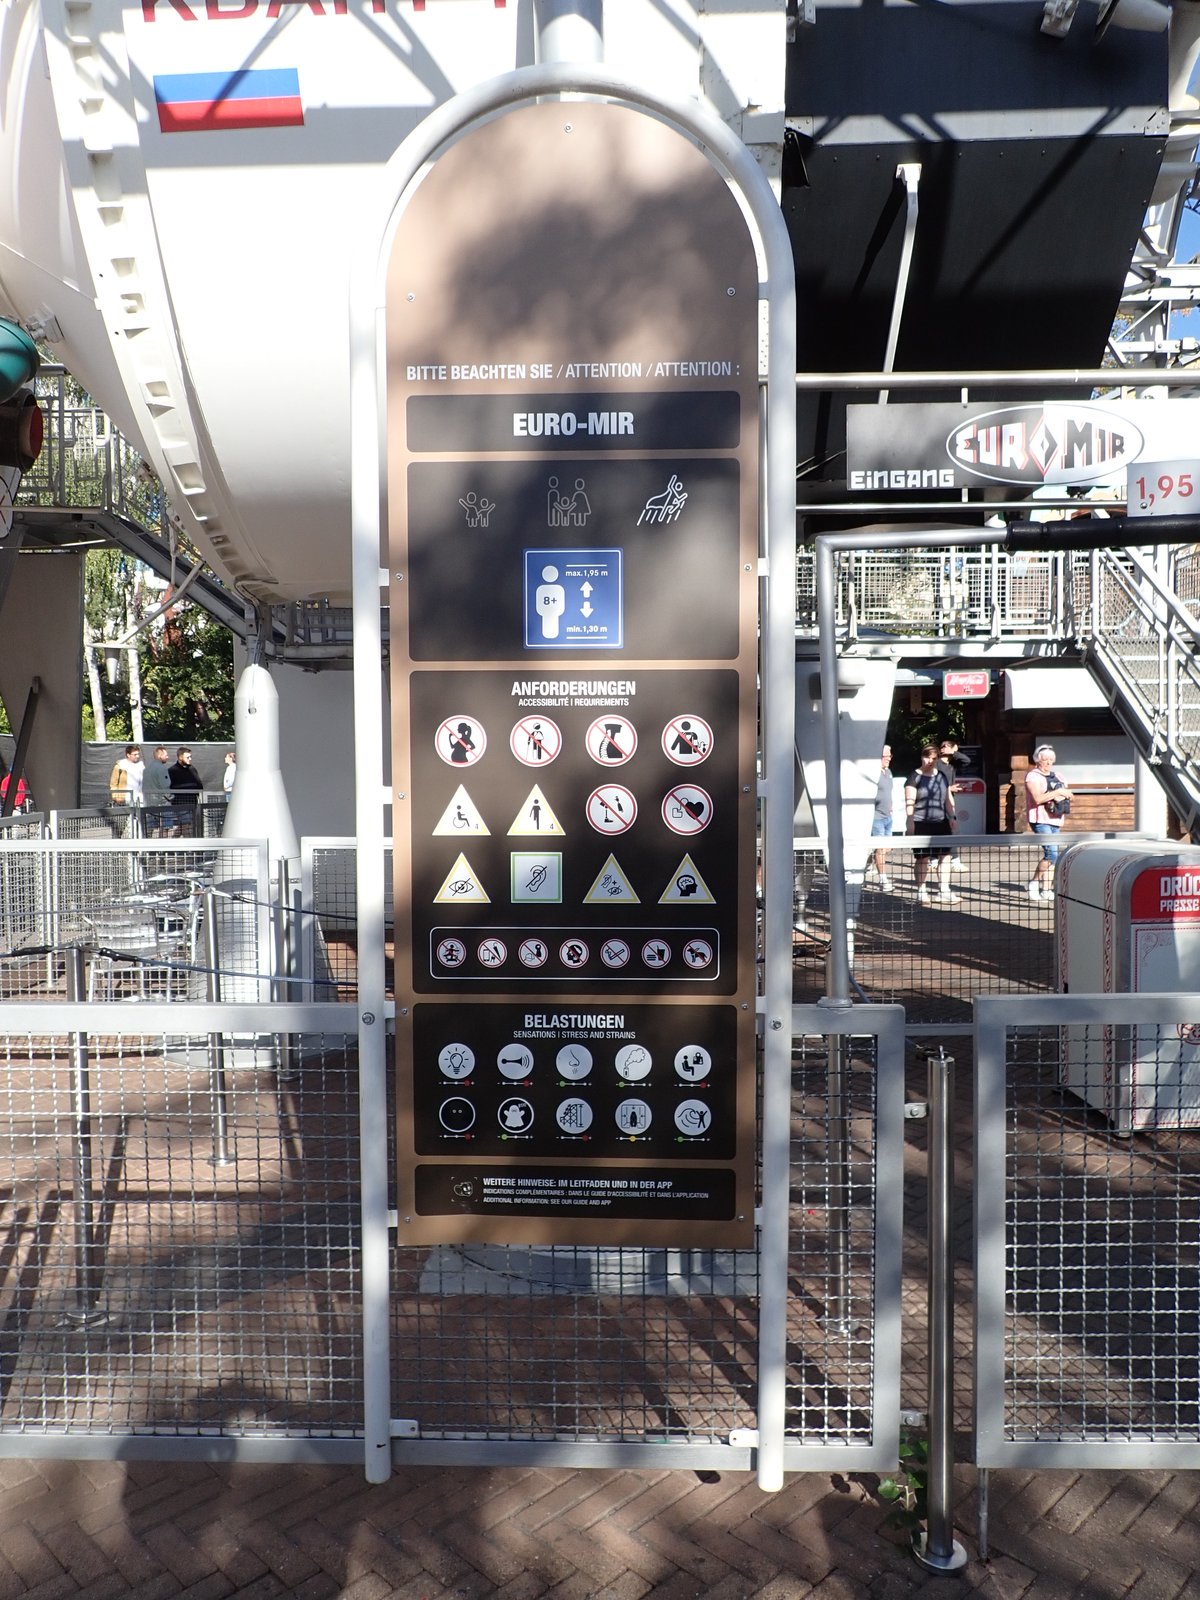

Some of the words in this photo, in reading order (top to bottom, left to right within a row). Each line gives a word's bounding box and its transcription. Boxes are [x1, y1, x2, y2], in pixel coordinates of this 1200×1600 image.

[406, 365, 447, 381] BITTE
[451, 364, 526, 380] BEACHTEN
[529, 363, 553, 379] SIE
[565, 362, 642, 378] ATTENTION
[654, 361, 732, 377] ATTENTION
[513, 411, 634, 436] EURO-MIR
[1135, 474, 1194, 507] 1,95
[543, 596, 557, 606] 8+
[511, 680, 636, 696] ANFORDERUNGEN
[518, 696, 569, 707] ACCESSIBILITÉ
[574, 697, 630, 707] REQUIREMENTS
[1160, 898, 1200, 912] PRESSE
[524, 1014, 625, 1029] BELASTUNGEN
[513, 1030, 556, 1039] SENSATIONS
[561, 1031, 589, 1039] STRESS
[589, 1031, 604, 1039] AND
[605, 1031, 636, 1039] STRAINS
[483, 1178, 516, 1187] WEITERE
[517, 1178, 557, 1187] HINWEISE:
[558, 1179, 568, 1188] IM
[569, 1179, 610, 1188] LEITFADEN
[611, 1180, 628, 1189] UND
[630, 1180, 638, 1189] IN
[640, 1180, 656, 1189] DER
[657, 1181, 673, 1190] APP
